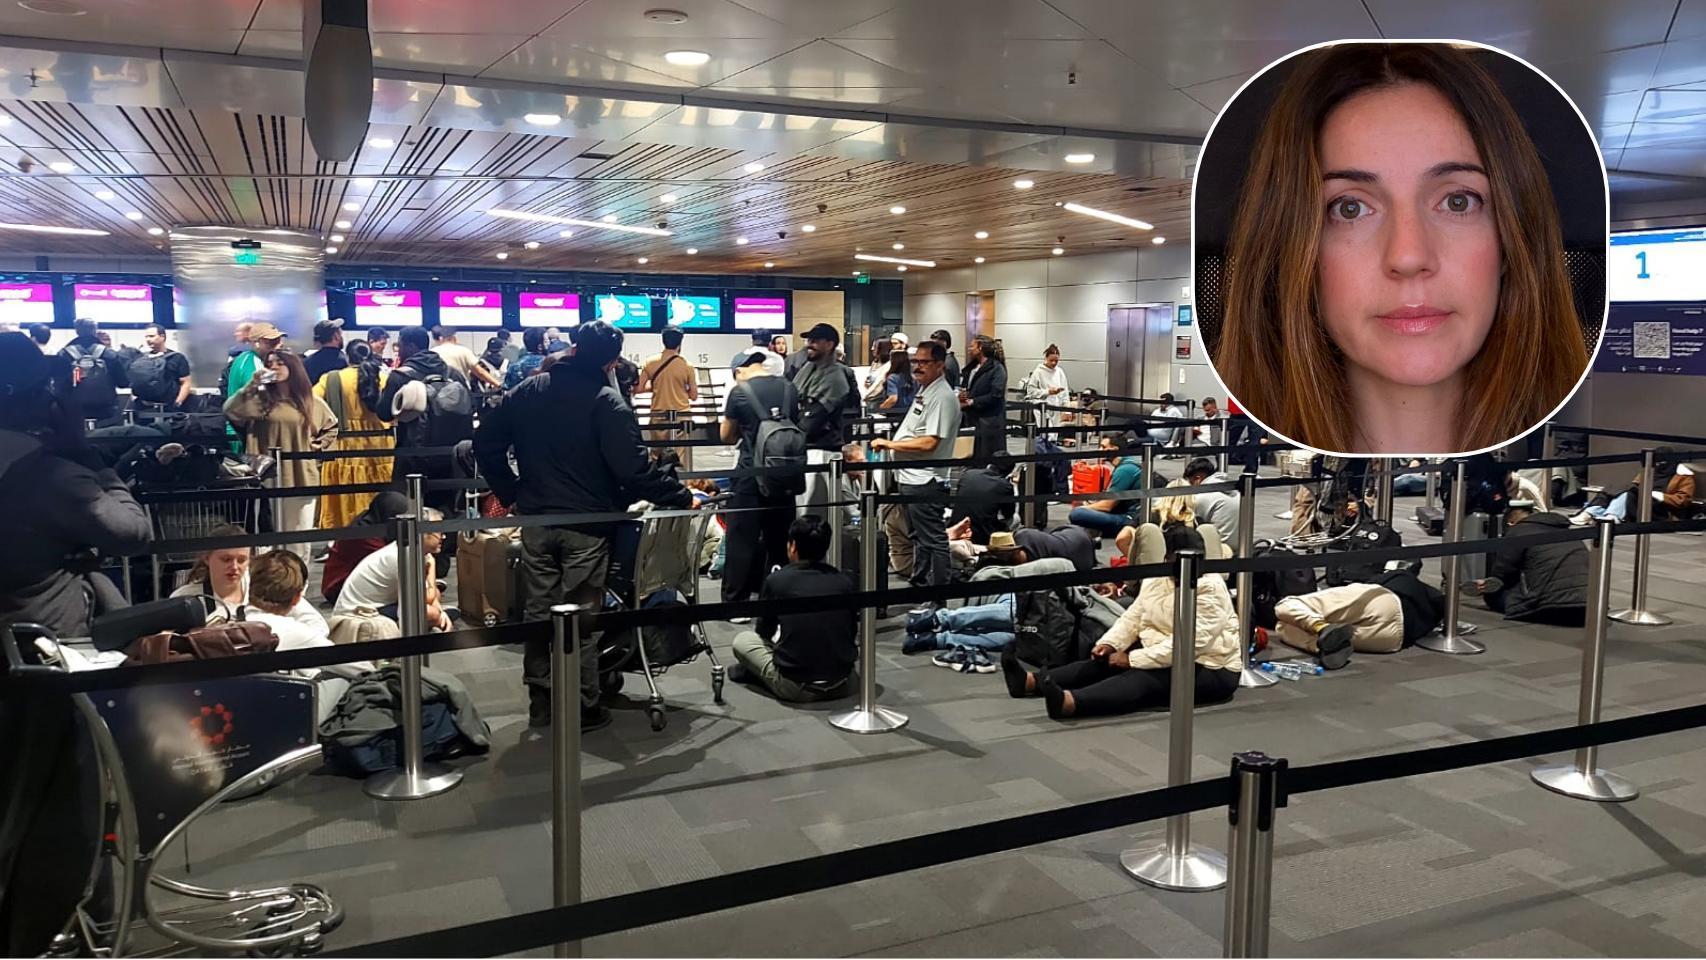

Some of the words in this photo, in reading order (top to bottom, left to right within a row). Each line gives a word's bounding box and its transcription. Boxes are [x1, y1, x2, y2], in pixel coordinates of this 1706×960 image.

[1635, 251, 1651, 279] 1
[628, 353, 640, 363] 14
[698, 353, 709, 364] 15
